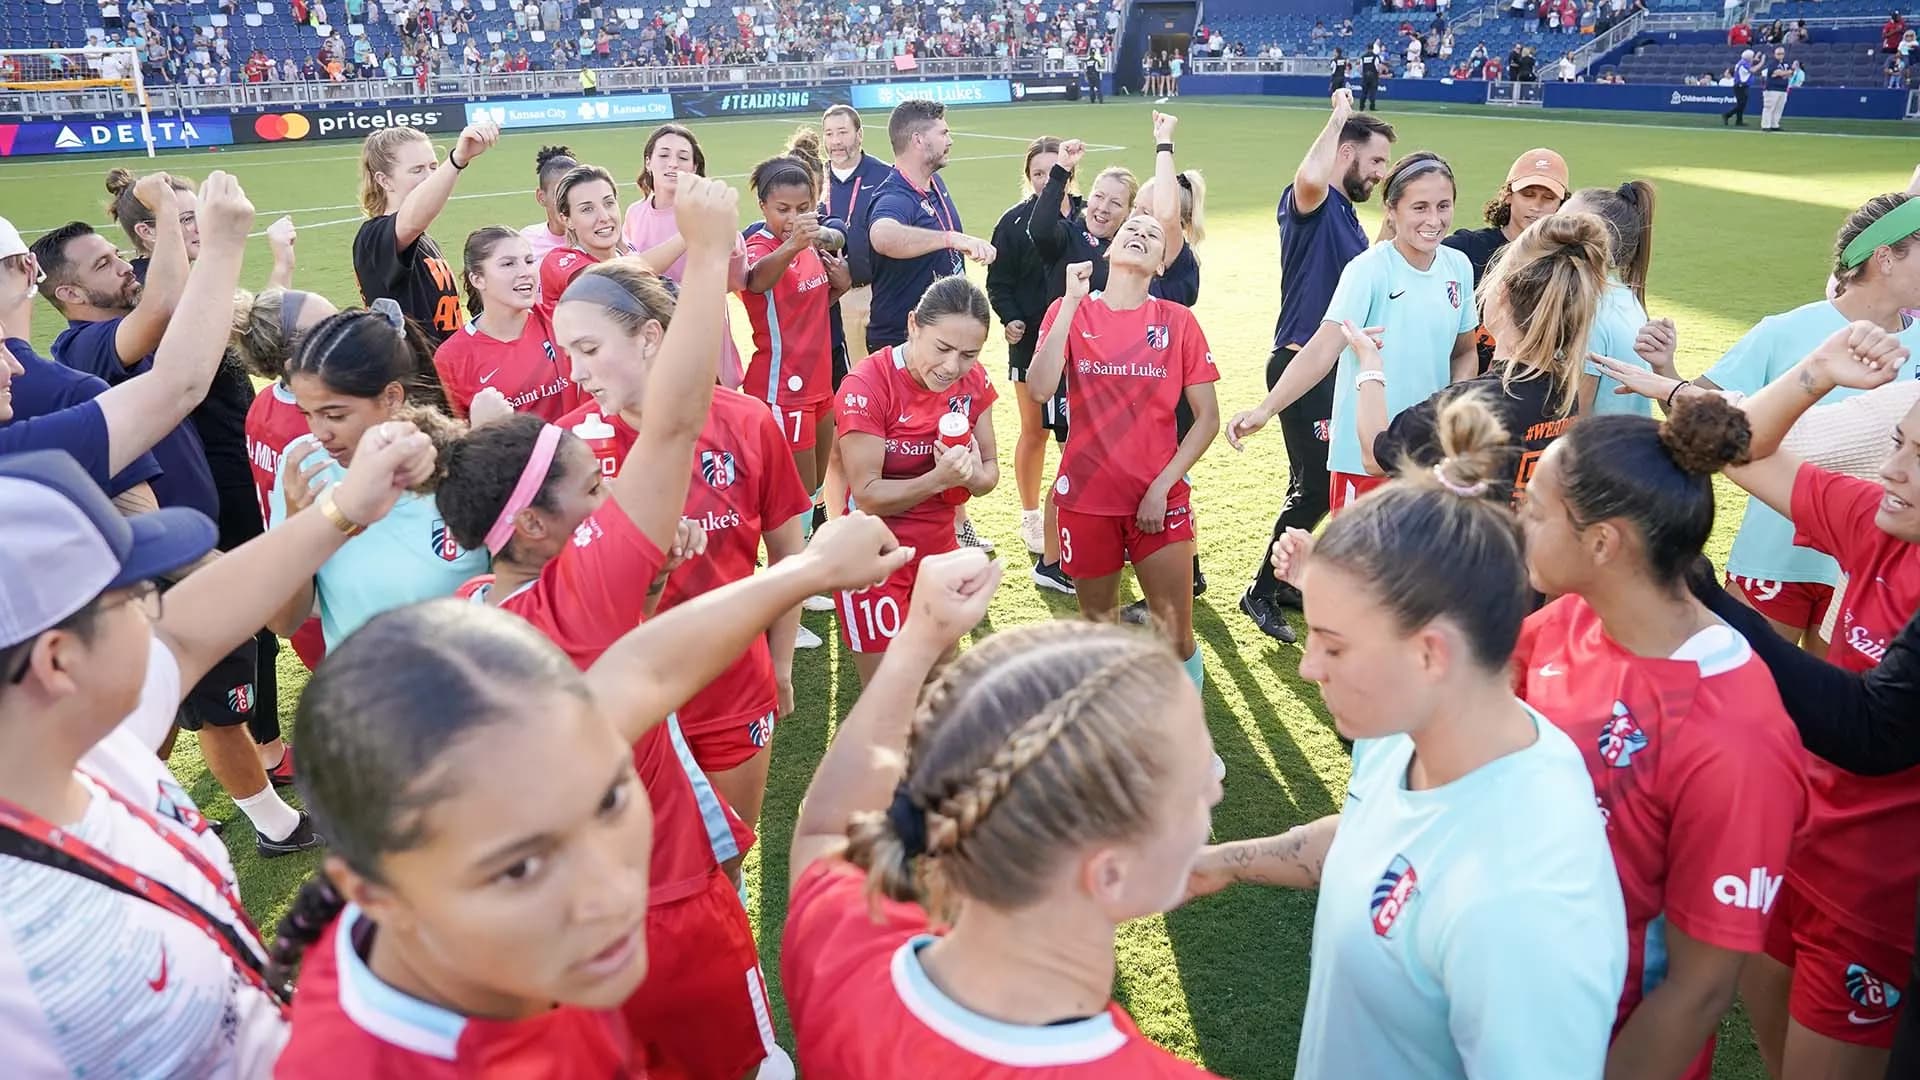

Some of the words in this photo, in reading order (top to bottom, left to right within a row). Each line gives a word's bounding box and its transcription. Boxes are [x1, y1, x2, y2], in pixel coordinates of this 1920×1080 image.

[721, 92, 809, 110] #TEALRISING
[937, 85, 982, 100] Luke's
[547, 108, 567, 119] City
[613, 104, 646, 114] Kansas
[647, 102, 667, 114] City
[318, 109, 440, 135] priceless
[1093, 361, 1128, 376] Saint
[1131, 362, 1168, 378] Luke's
[788, 410, 802, 443] 7
[900, 441, 933, 456] Sain
[1061, 527, 1073, 564] 3
[860, 596, 900, 640] 10
[1712, 866, 1784, 915] ally
